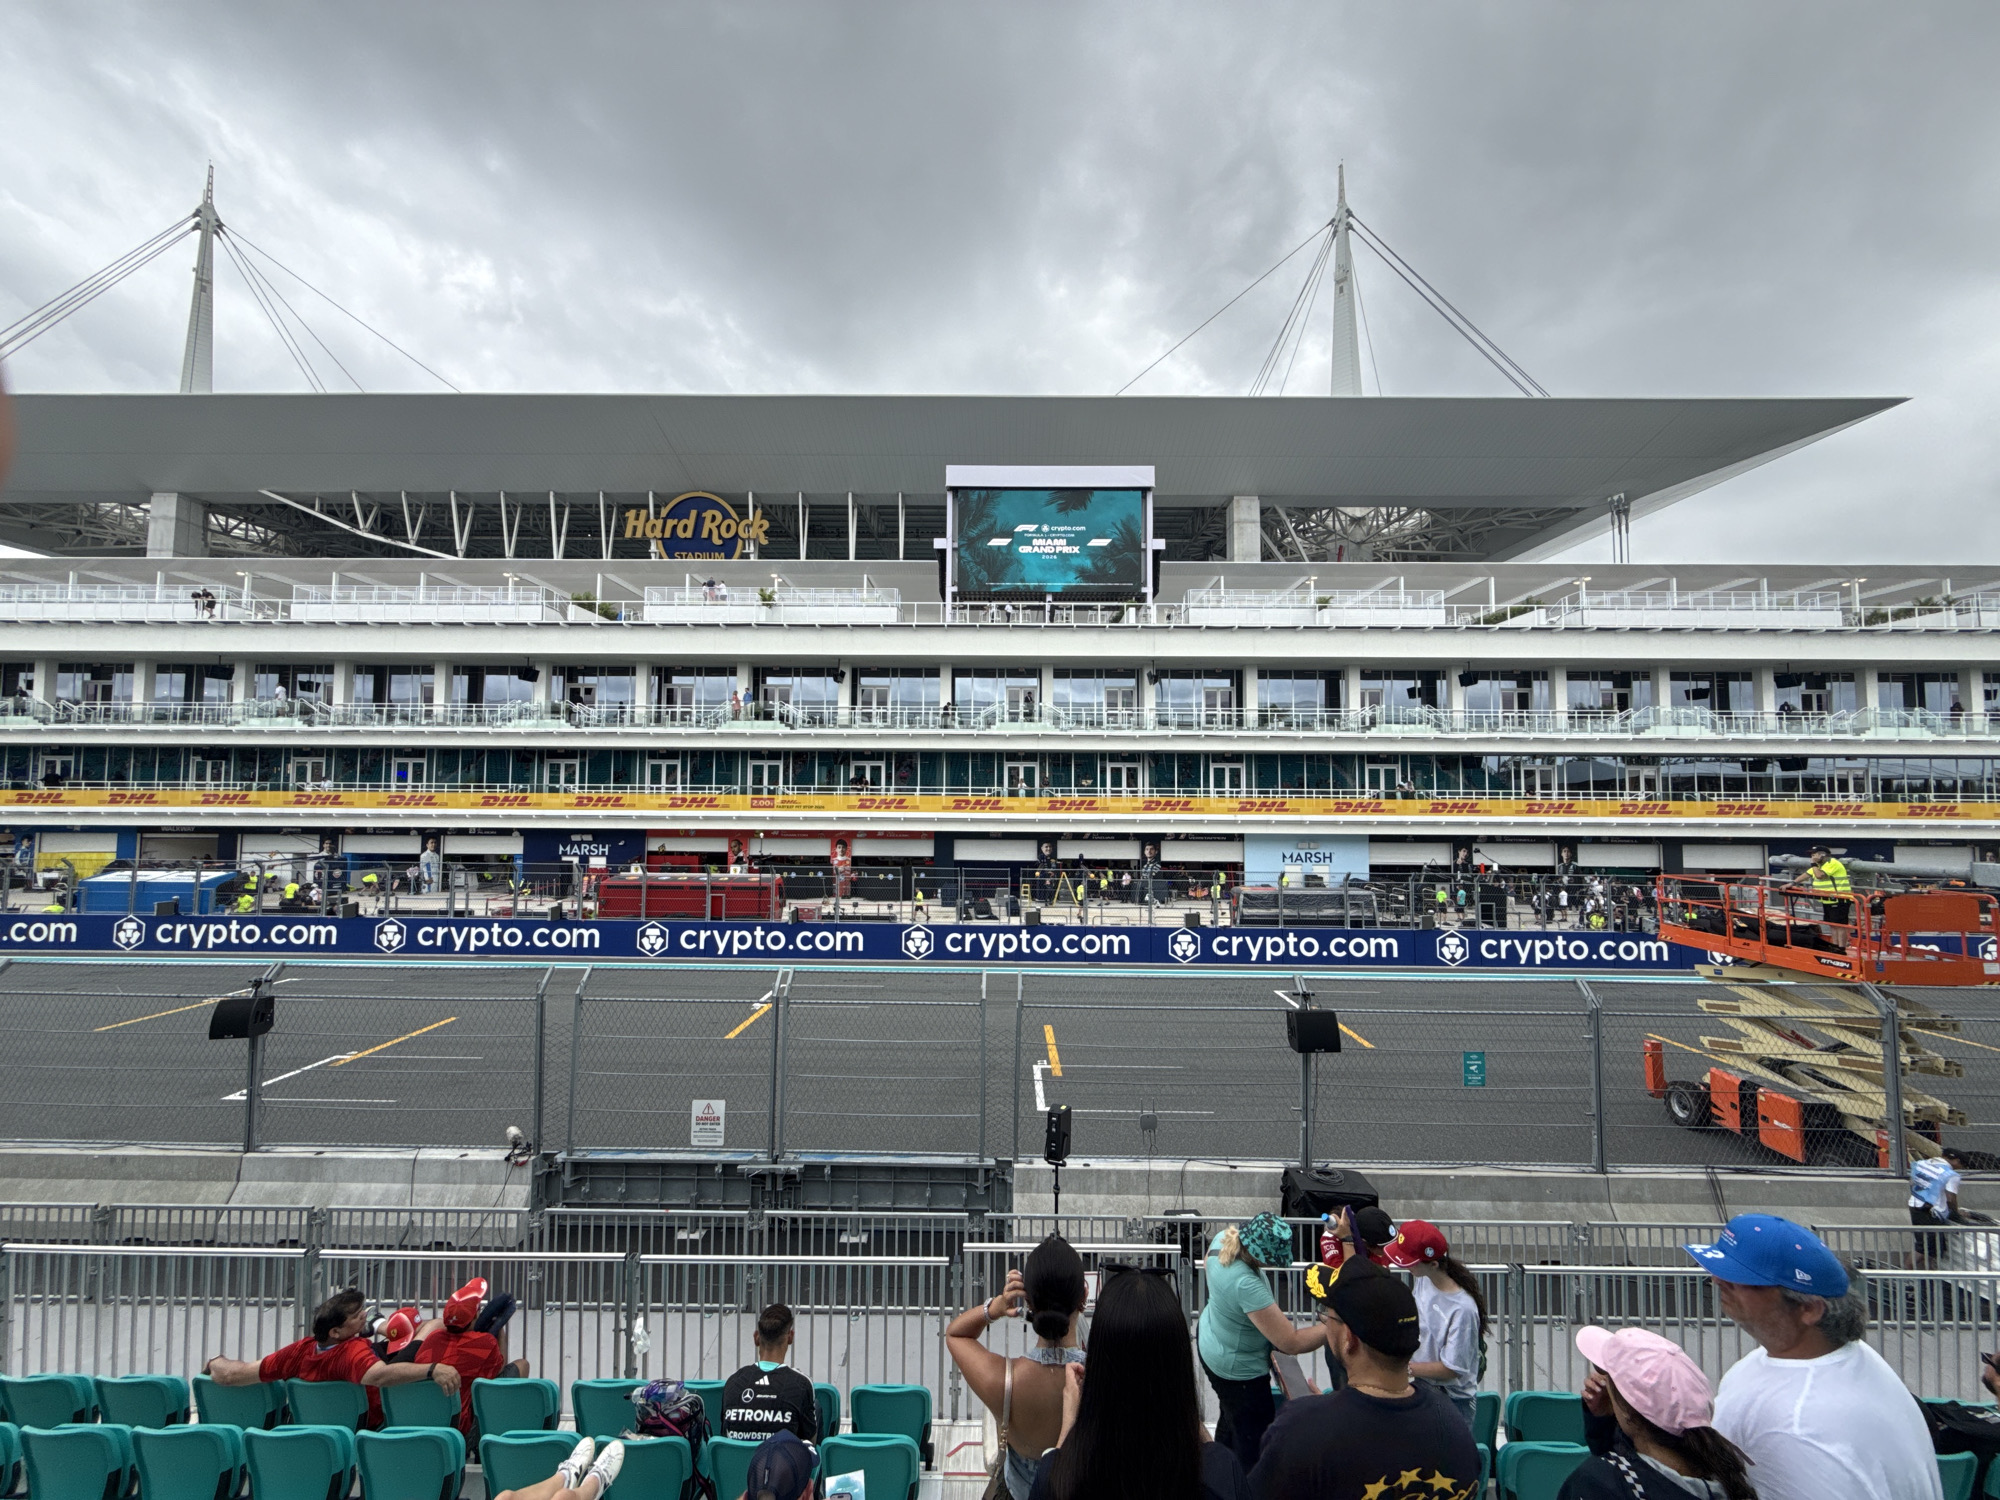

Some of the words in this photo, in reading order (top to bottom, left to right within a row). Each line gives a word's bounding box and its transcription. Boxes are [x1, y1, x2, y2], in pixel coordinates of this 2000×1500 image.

[624, 509, 698, 539] Hard
[701, 509, 770, 546] Rock
[1032, 538, 1067, 546] MIAMI
[674, 551, 725, 560] STADIUM
[15, 793, 66, 804] DHL
[108, 793, 159, 805] DHL
[200, 794, 251, 805] DHL
[292, 794, 344, 806] DHL
[386, 795, 438, 807] DHL
[480, 796, 532, 807] DHL
[574, 796, 625, 808] DHL
[668, 797, 720, 808] DHL
[857, 798, 910, 810] DHL
[951, 799, 1004, 810] DHL
[1047, 800, 1099, 811] DHL
[1142, 800, 1195, 812] DHL
[1237, 801, 1290, 813] DHL
[1333, 802, 1386, 814] DHL
[1429, 802, 1482, 814] DHL
[1525, 803, 1578, 815] DHL
[1619, 804, 1672, 815] DHL
[1715, 804, 1768, 816] DHL
[1813, 805, 1866, 817] DHL
[1907, 805, 1960, 817] DHL
[558, 843, 609, 856] MARSH
[1282, 851, 1333, 864] MARSH
[155, 919, 338, 949] crypto.com
[416, 922, 600, 952] crypto.com
[679, 926, 864, 955] crypto.com
[944, 929, 1131, 958] crypto.com
[1212, 932, 1399, 962] crypto.com
[1480, 934, 1669, 965] crypto.com
[724, 1408, 793, 1423] PETRONAS
[728, 1430, 775, 1440] CROWDSTR
